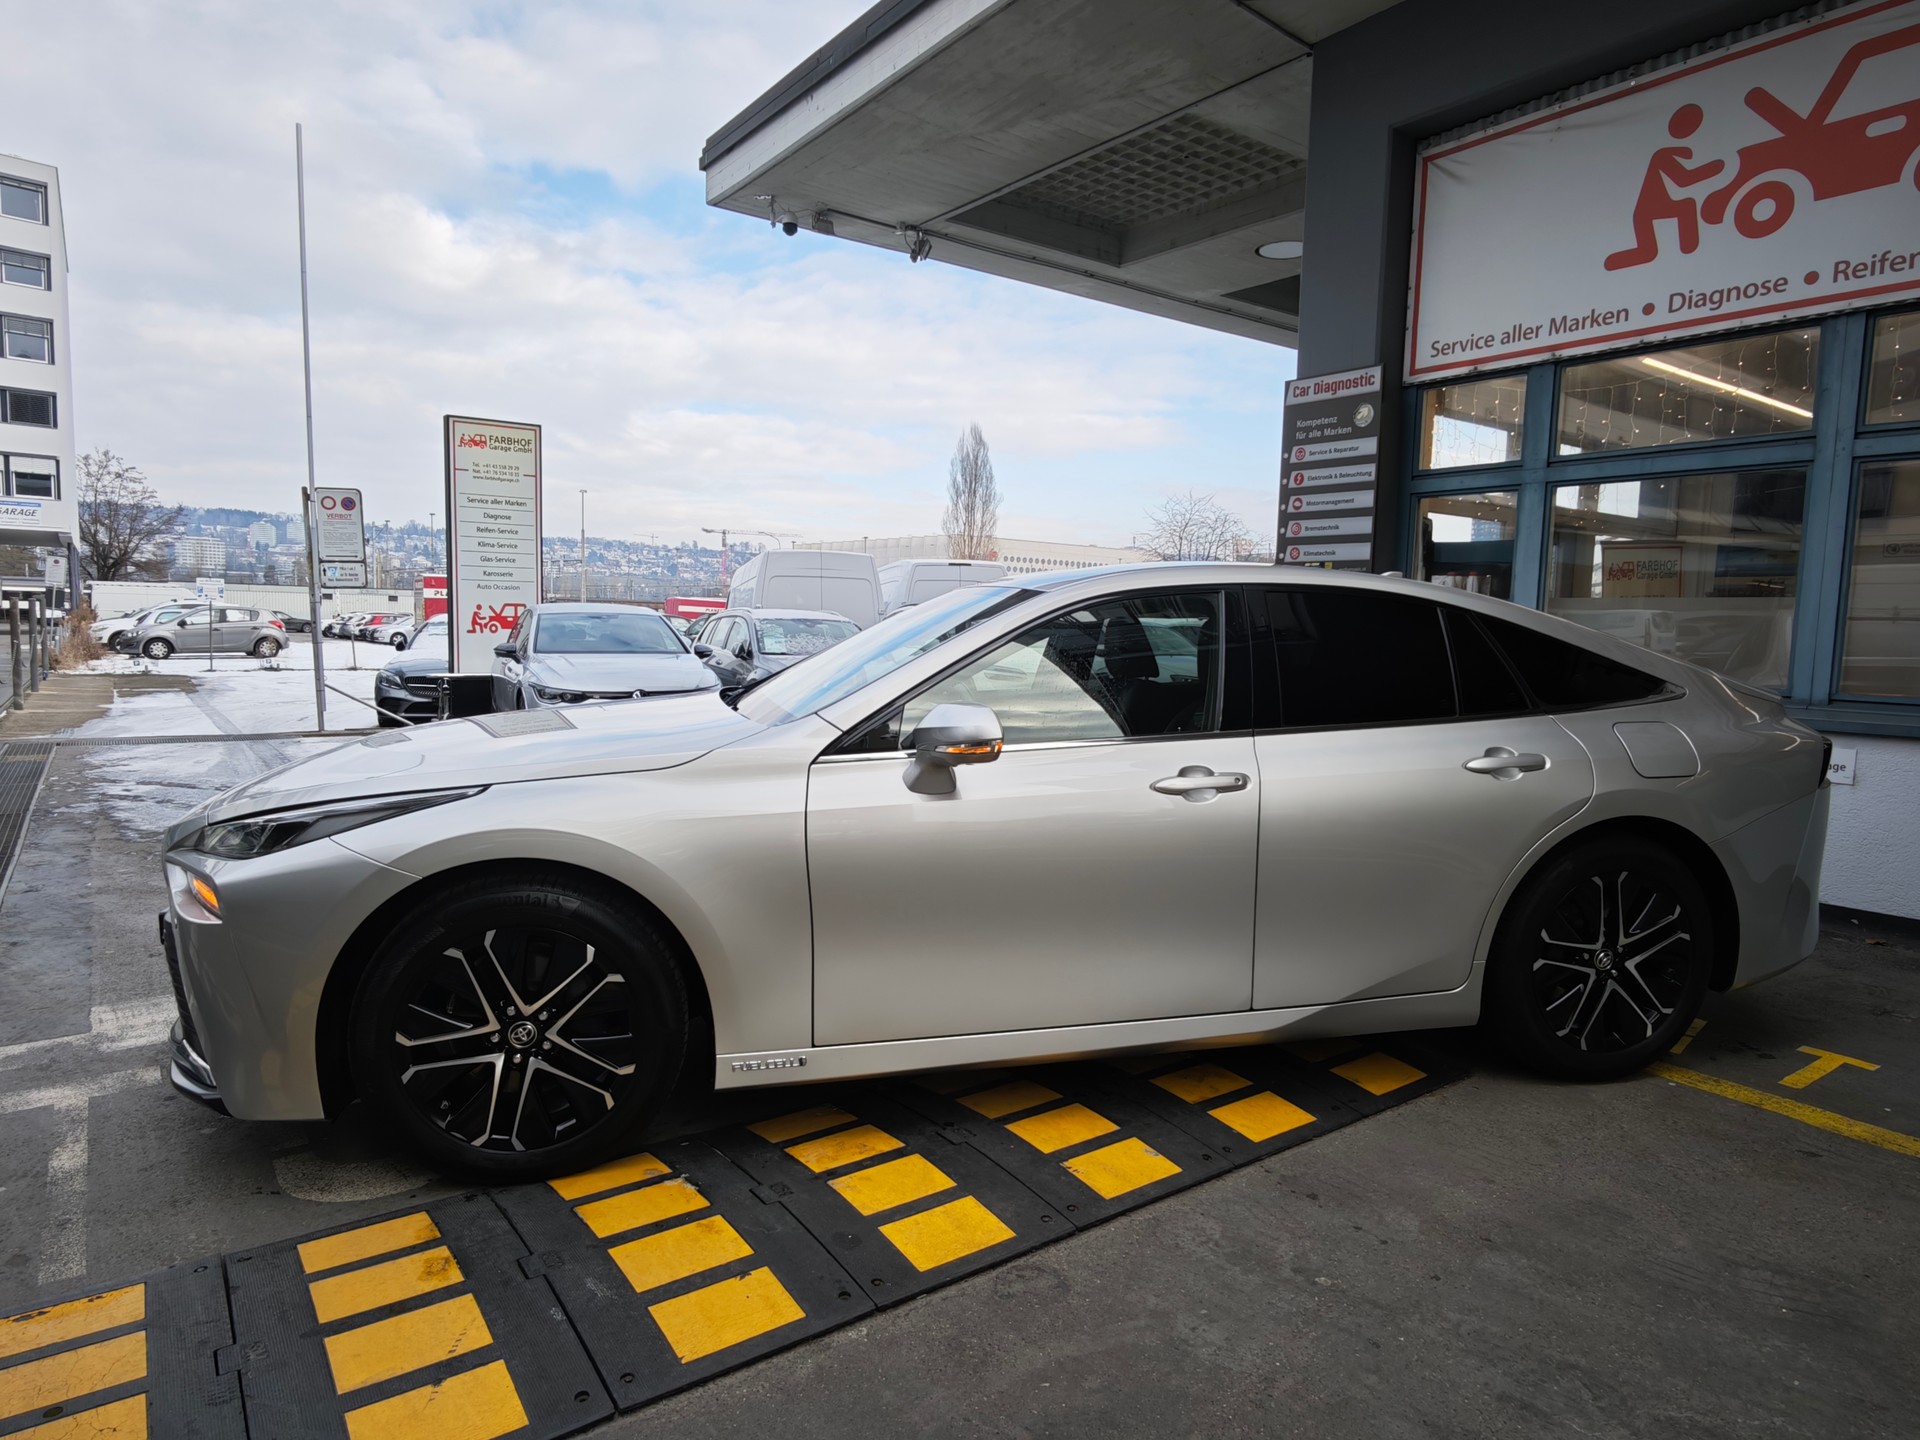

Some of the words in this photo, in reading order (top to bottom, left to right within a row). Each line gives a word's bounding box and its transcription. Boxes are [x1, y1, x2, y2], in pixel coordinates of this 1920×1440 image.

[1429, 333, 1496, 359] Service
[1500, 322, 1543, 346] aller
[1548, 307, 1630, 337] Marken
[1667, 276, 1789, 314] Diagnose
[1293, 385, 1311, 398] Car
[1313, 373, 1376, 396] Diagnostic
[1296, 416, 1338, 428] Kompetenz
[1296, 431, 1306, 440] für
[1308, 429, 1322, 438] alle
[1323, 426, 1352, 437] Marken
[488, 435, 532, 447] FARBHOF
[488, 444, 512, 452] Garage
[513, 446, 532, 454] GmbH
[467, 497, 489, 505] Service
[490, 498, 503, 506] aller
[504, 499, 527, 507] Marken
[1306, 498, 1354, 506] Motormanagement
[483, 512, 512, 521] Diagnose
[476, 526, 519, 535] Reifen-Service
[478, 541, 518, 549] Klima-Service
[480, 555, 516, 564] Glas-Service
[1636, 560, 1678, 571] FARBHOF
